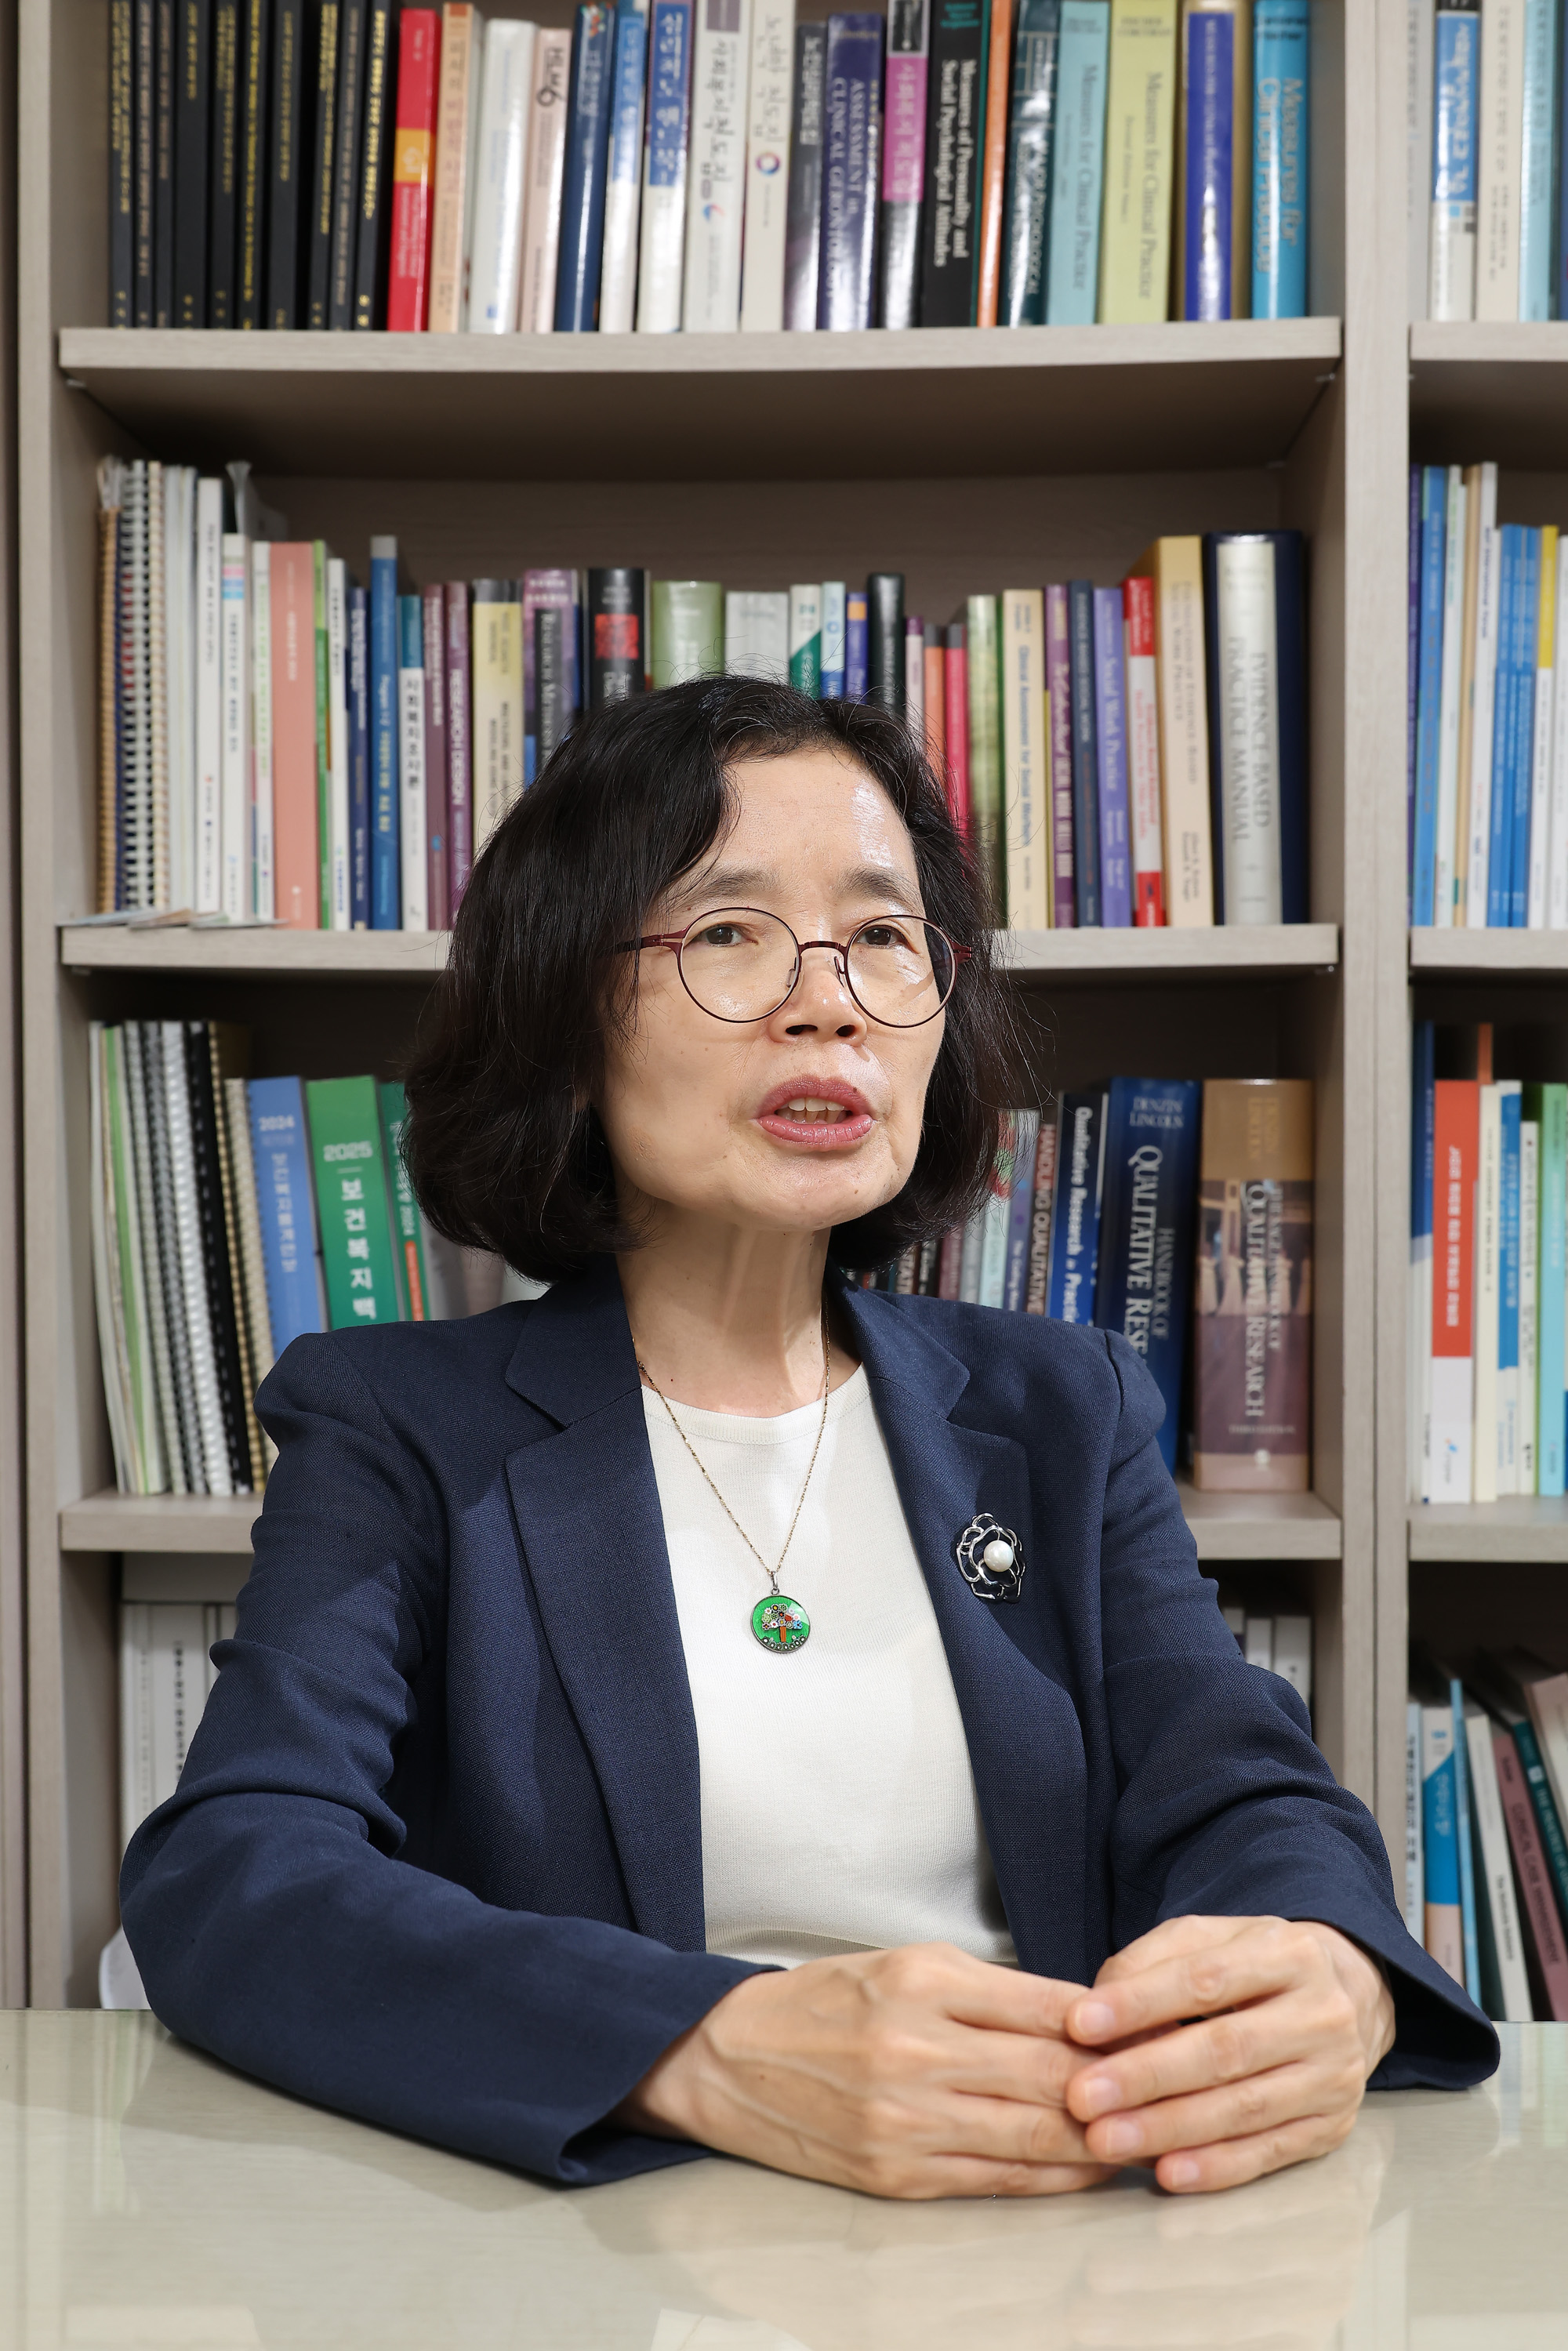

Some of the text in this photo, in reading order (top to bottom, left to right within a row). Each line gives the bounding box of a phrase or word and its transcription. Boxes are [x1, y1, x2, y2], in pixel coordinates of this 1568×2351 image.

[829, 77, 848, 163] CLINICAL
[848, 79, 866, 193] ASSESSMENT
[932, 60, 959, 269] Social Psychological Attitudes
[950, 60, 977, 259] Measures of Personality and
[1255, 77, 1282, 274] Clinical Practice
[1279, 77, 1303, 248] Measures for
[1072, 65, 1099, 290] Measures for Clinical Practice
[1138, 71, 1163, 300] Measures for Clinical Practice
[406, 678, 423, 791] 사회복지조사론
[450, 668, 466, 806] RESEARCH DESIGN
[1103, 657, 1122, 792] Social Work Practice
[1229, 748, 1251, 842] MANUAL
[323, 1140, 374, 1162] 2025
[1069, 1105, 1094, 1186] Qualitative
[1129, 1112, 1185, 1129] LINCOLN
[1131, 1097, 1184, 1113] DENZIN
[1034, 1123, 1057, 1210] HANDLING
[1065, 1187, 1089, 1257] Research
[1127, 1144, 1164, 1292] QUALITATIVE
[1152, 1227, 1177, 1341] HANDBOOK OF
[1240, 1181, 1269, 1417] QUALITATIVE RESEARCH
